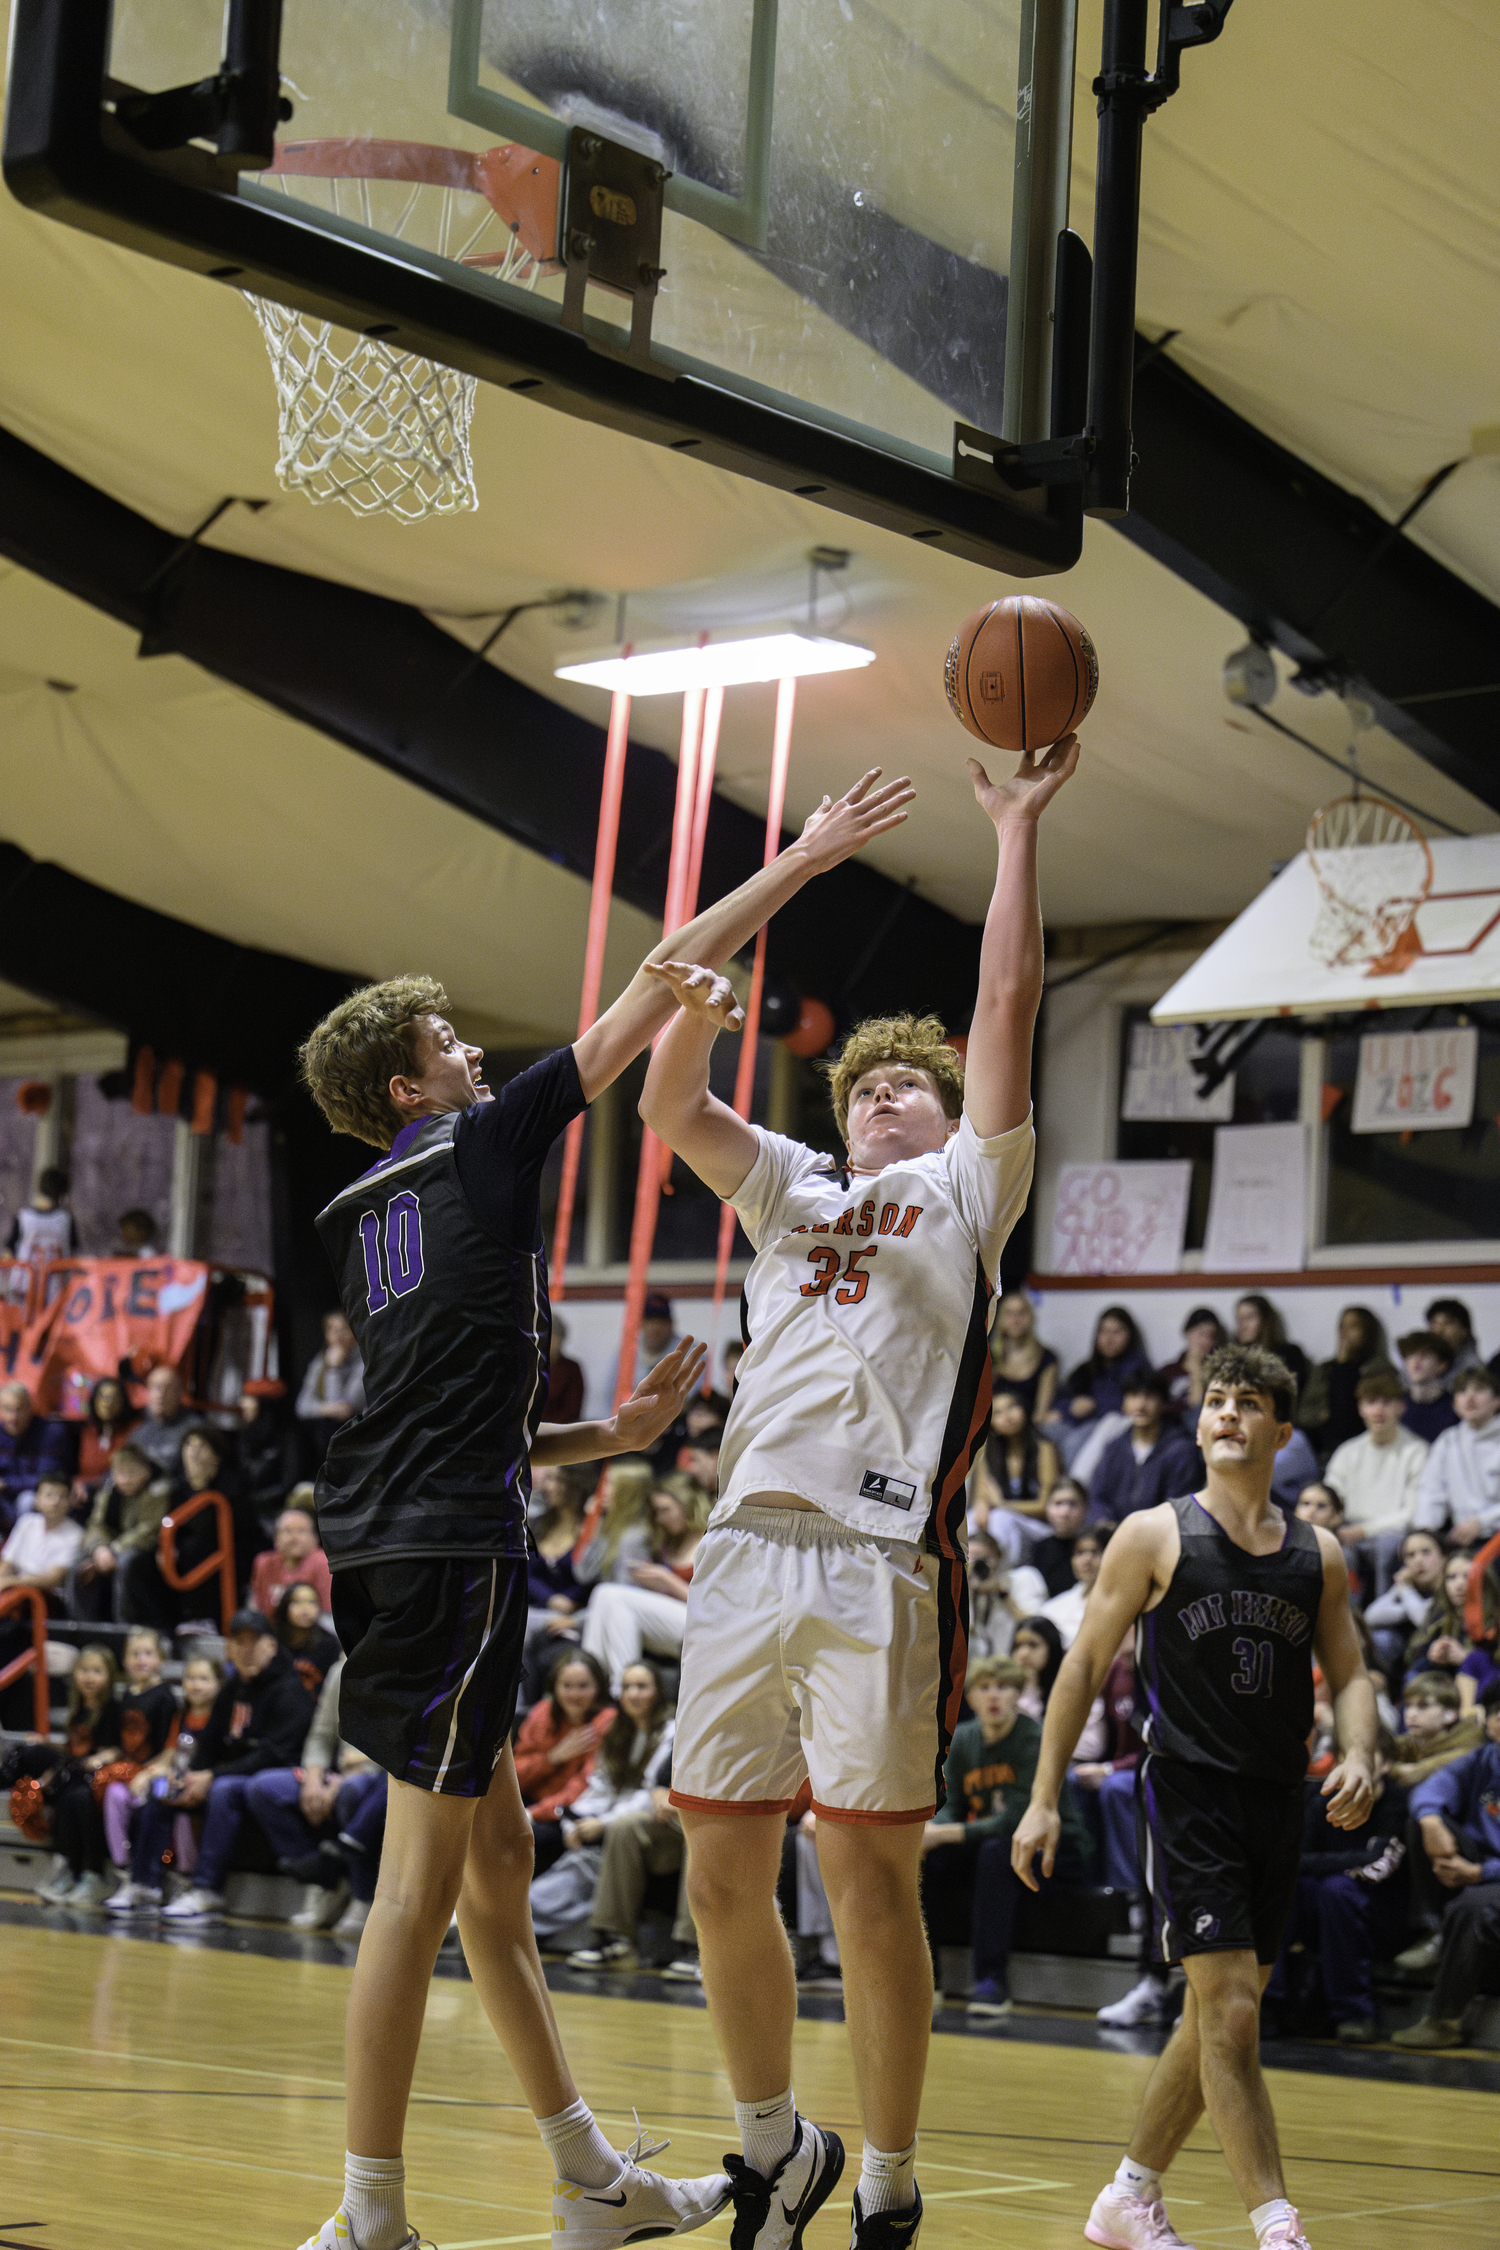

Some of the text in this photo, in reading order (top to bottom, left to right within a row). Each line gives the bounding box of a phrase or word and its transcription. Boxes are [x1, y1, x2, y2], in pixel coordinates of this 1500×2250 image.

[358, 1190, 425, 1317] 10
[799, 1245, 878, 1305] 35
[1177, 1590, 1310, 1647] PORT JEFFERSON
[1231, 1637, 1274, 1697] 31
